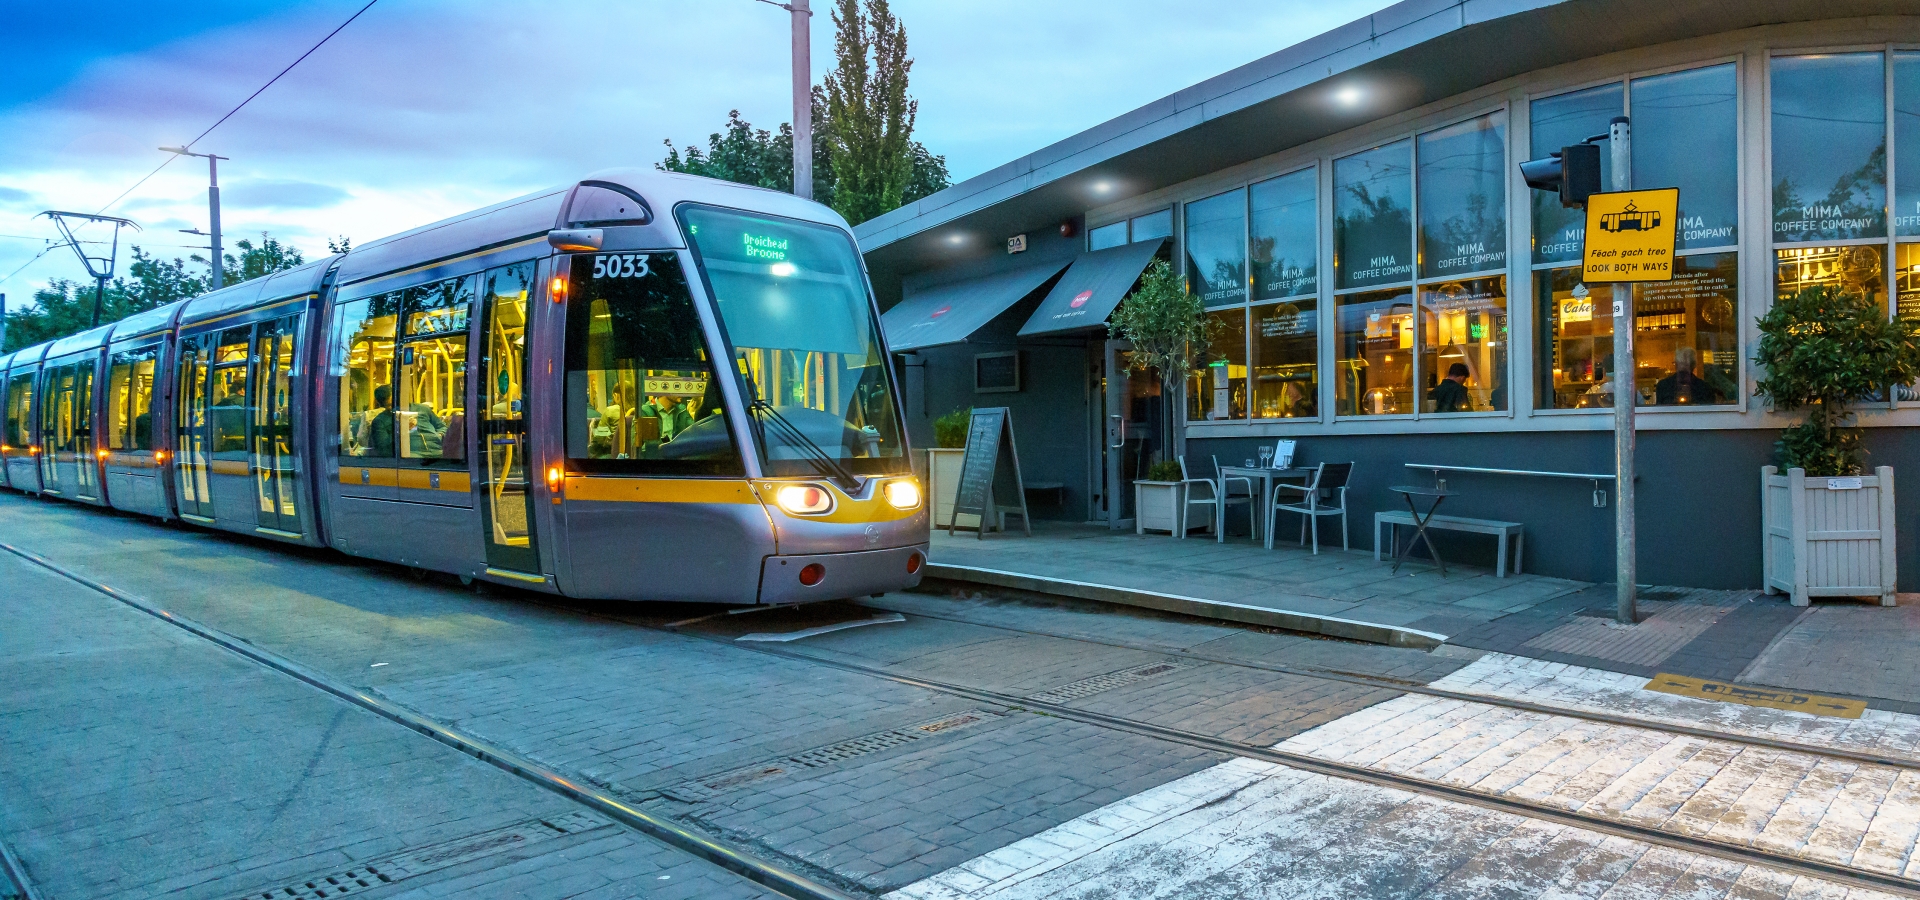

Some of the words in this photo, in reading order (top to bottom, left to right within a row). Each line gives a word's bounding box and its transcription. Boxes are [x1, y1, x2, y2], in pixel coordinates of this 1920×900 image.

[1802, 205, 1842, 219] MIMA
[1678, 215, 1704, 230] IMA
[1774, 220, 1817, 232] COFFEE
[1821, 218, 1872, 230] COMPANY
[1895, 216, 1920, 226] OFFE
[691, 226, 698, 234] 5
[1565, 229, 1585, 241] MI
[1683, 226, 1733, 241] COMPANY
[743, 233, 788, 250] Droichead
[1541, 242, 1579, 254] COFFEE
[746, 245, 785, 260] Broome
[1457, 242, 1485, 256] MIMA
[1621, 248, 1643, 258] gach
[1647, 247, 1667, 256] treo
[592, 254, 650, 279] 5033
[1370, 255, 1396, 268] MIMA
[1438, 256, 1467, 269] COFFEE
[1470, 251, 1506, 264] COMPANY
[1282, 268, 1304, 280] MIMA
[1353, 268, 1380, 280] COFFEE
[1586, 264, 1610, 273] LOOK
[1614, 263, 1638, 272] BOTH
[1642, 262, 1669, 271] WAYS
[1217, 278, 1238, 290] MIMA
[1267, 280, 1290, 291] COFFEE
[1204, 290, 1225, 301] COFFEE
[1226, 287, 1246, 298] COMPA
[1563, 301, 1597, 314] Cakes
